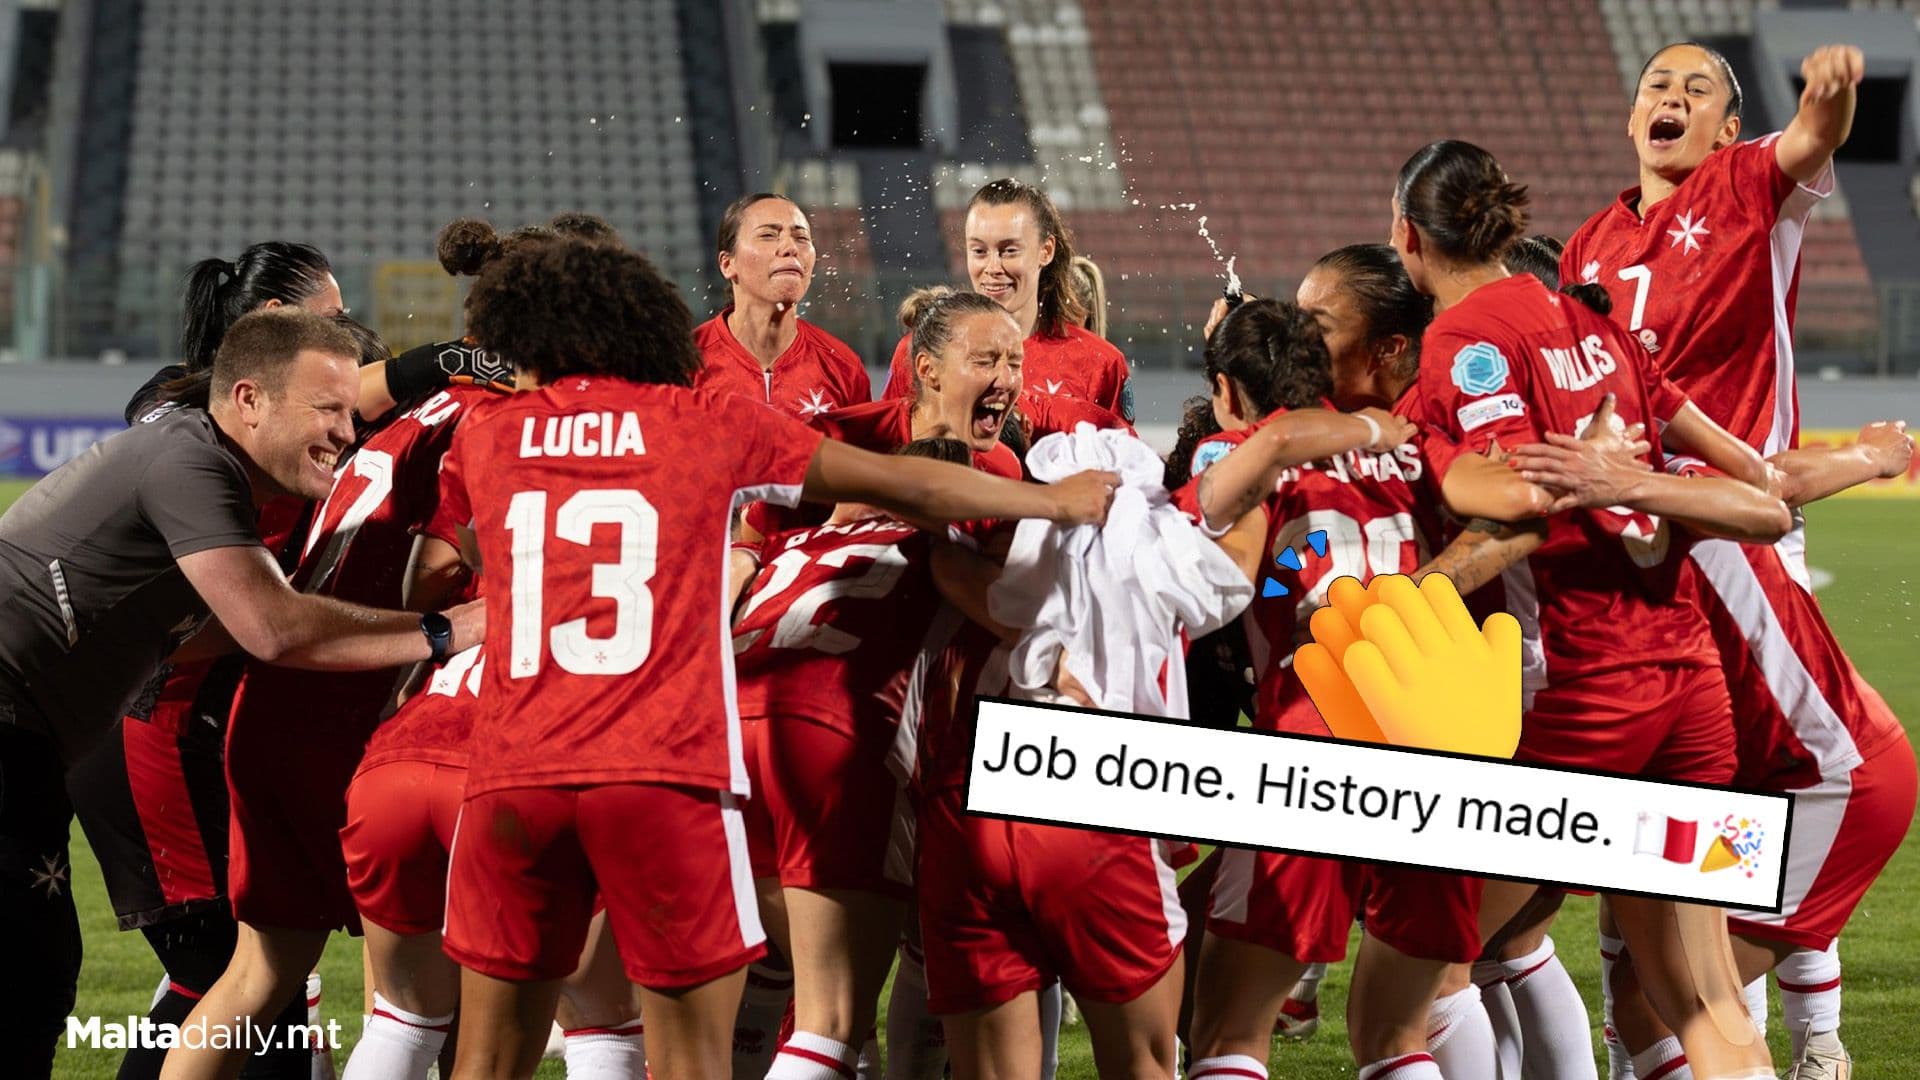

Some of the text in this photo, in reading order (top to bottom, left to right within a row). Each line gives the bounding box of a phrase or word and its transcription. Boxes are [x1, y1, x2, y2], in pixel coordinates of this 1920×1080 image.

[1618, 264, 1652, 332] 7
[1540, 334, 1617, 392] WILLIS
[520, 411, 647, 459] LUCIA
[504, 489, 660, 679] 13
